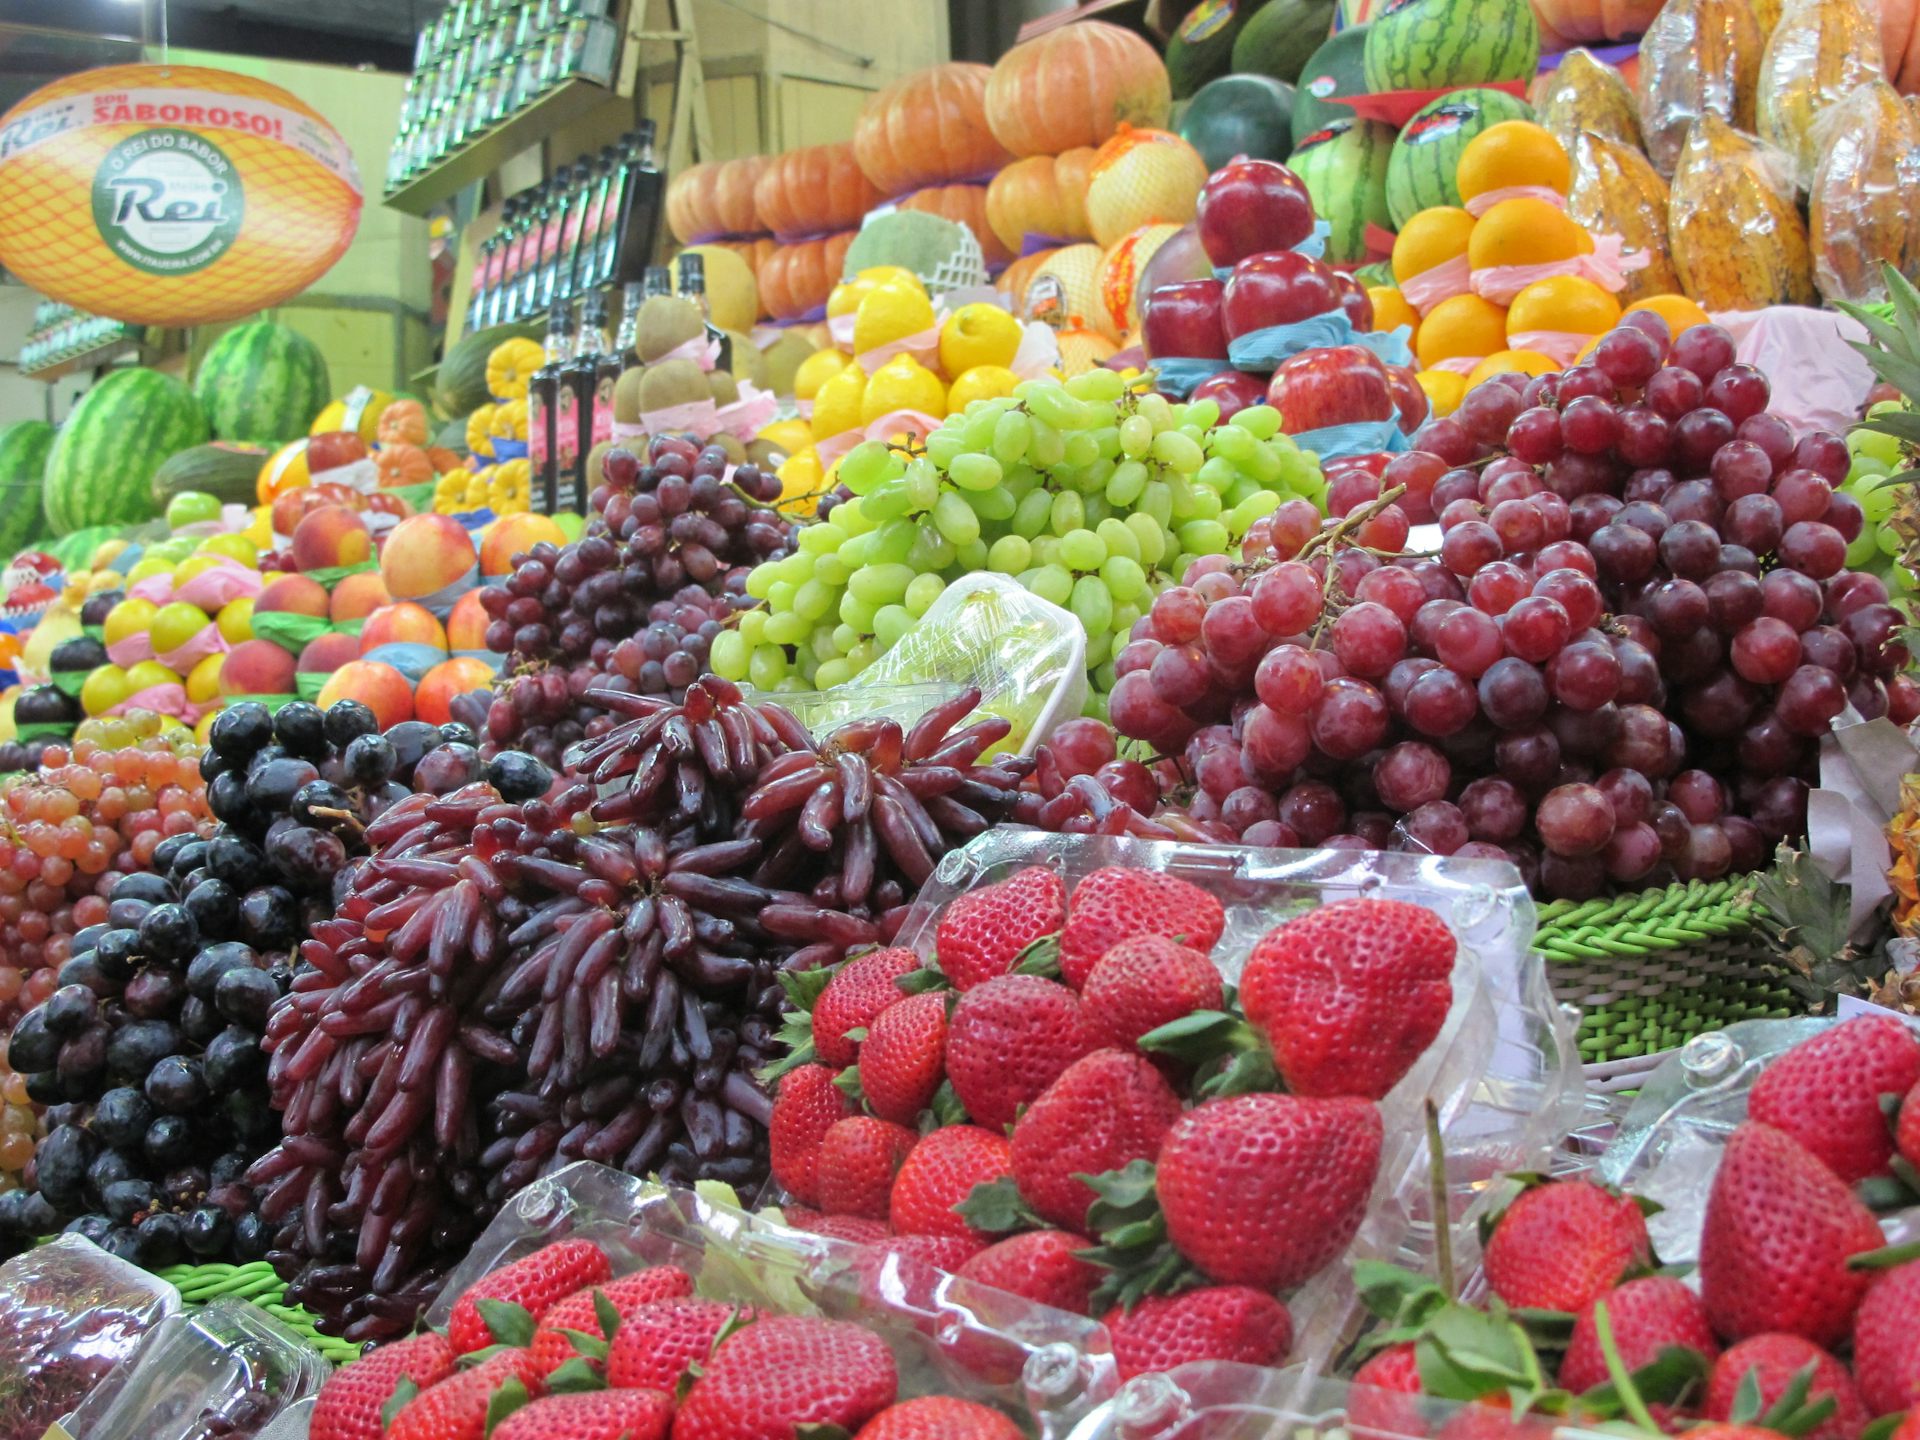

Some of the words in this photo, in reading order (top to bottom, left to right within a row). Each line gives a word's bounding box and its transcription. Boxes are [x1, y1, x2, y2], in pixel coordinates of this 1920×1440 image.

[94, 94, 128, 106] SOU
[93, 104, 283, 141] SABOROSO!
[111, 157, 125, 170] O
[122, 138, 149, 159] REI
[151, 134, 174, 148] DO
[178, 136, 228, 174] SABOR
[110, 177, 228, 224] Rei
